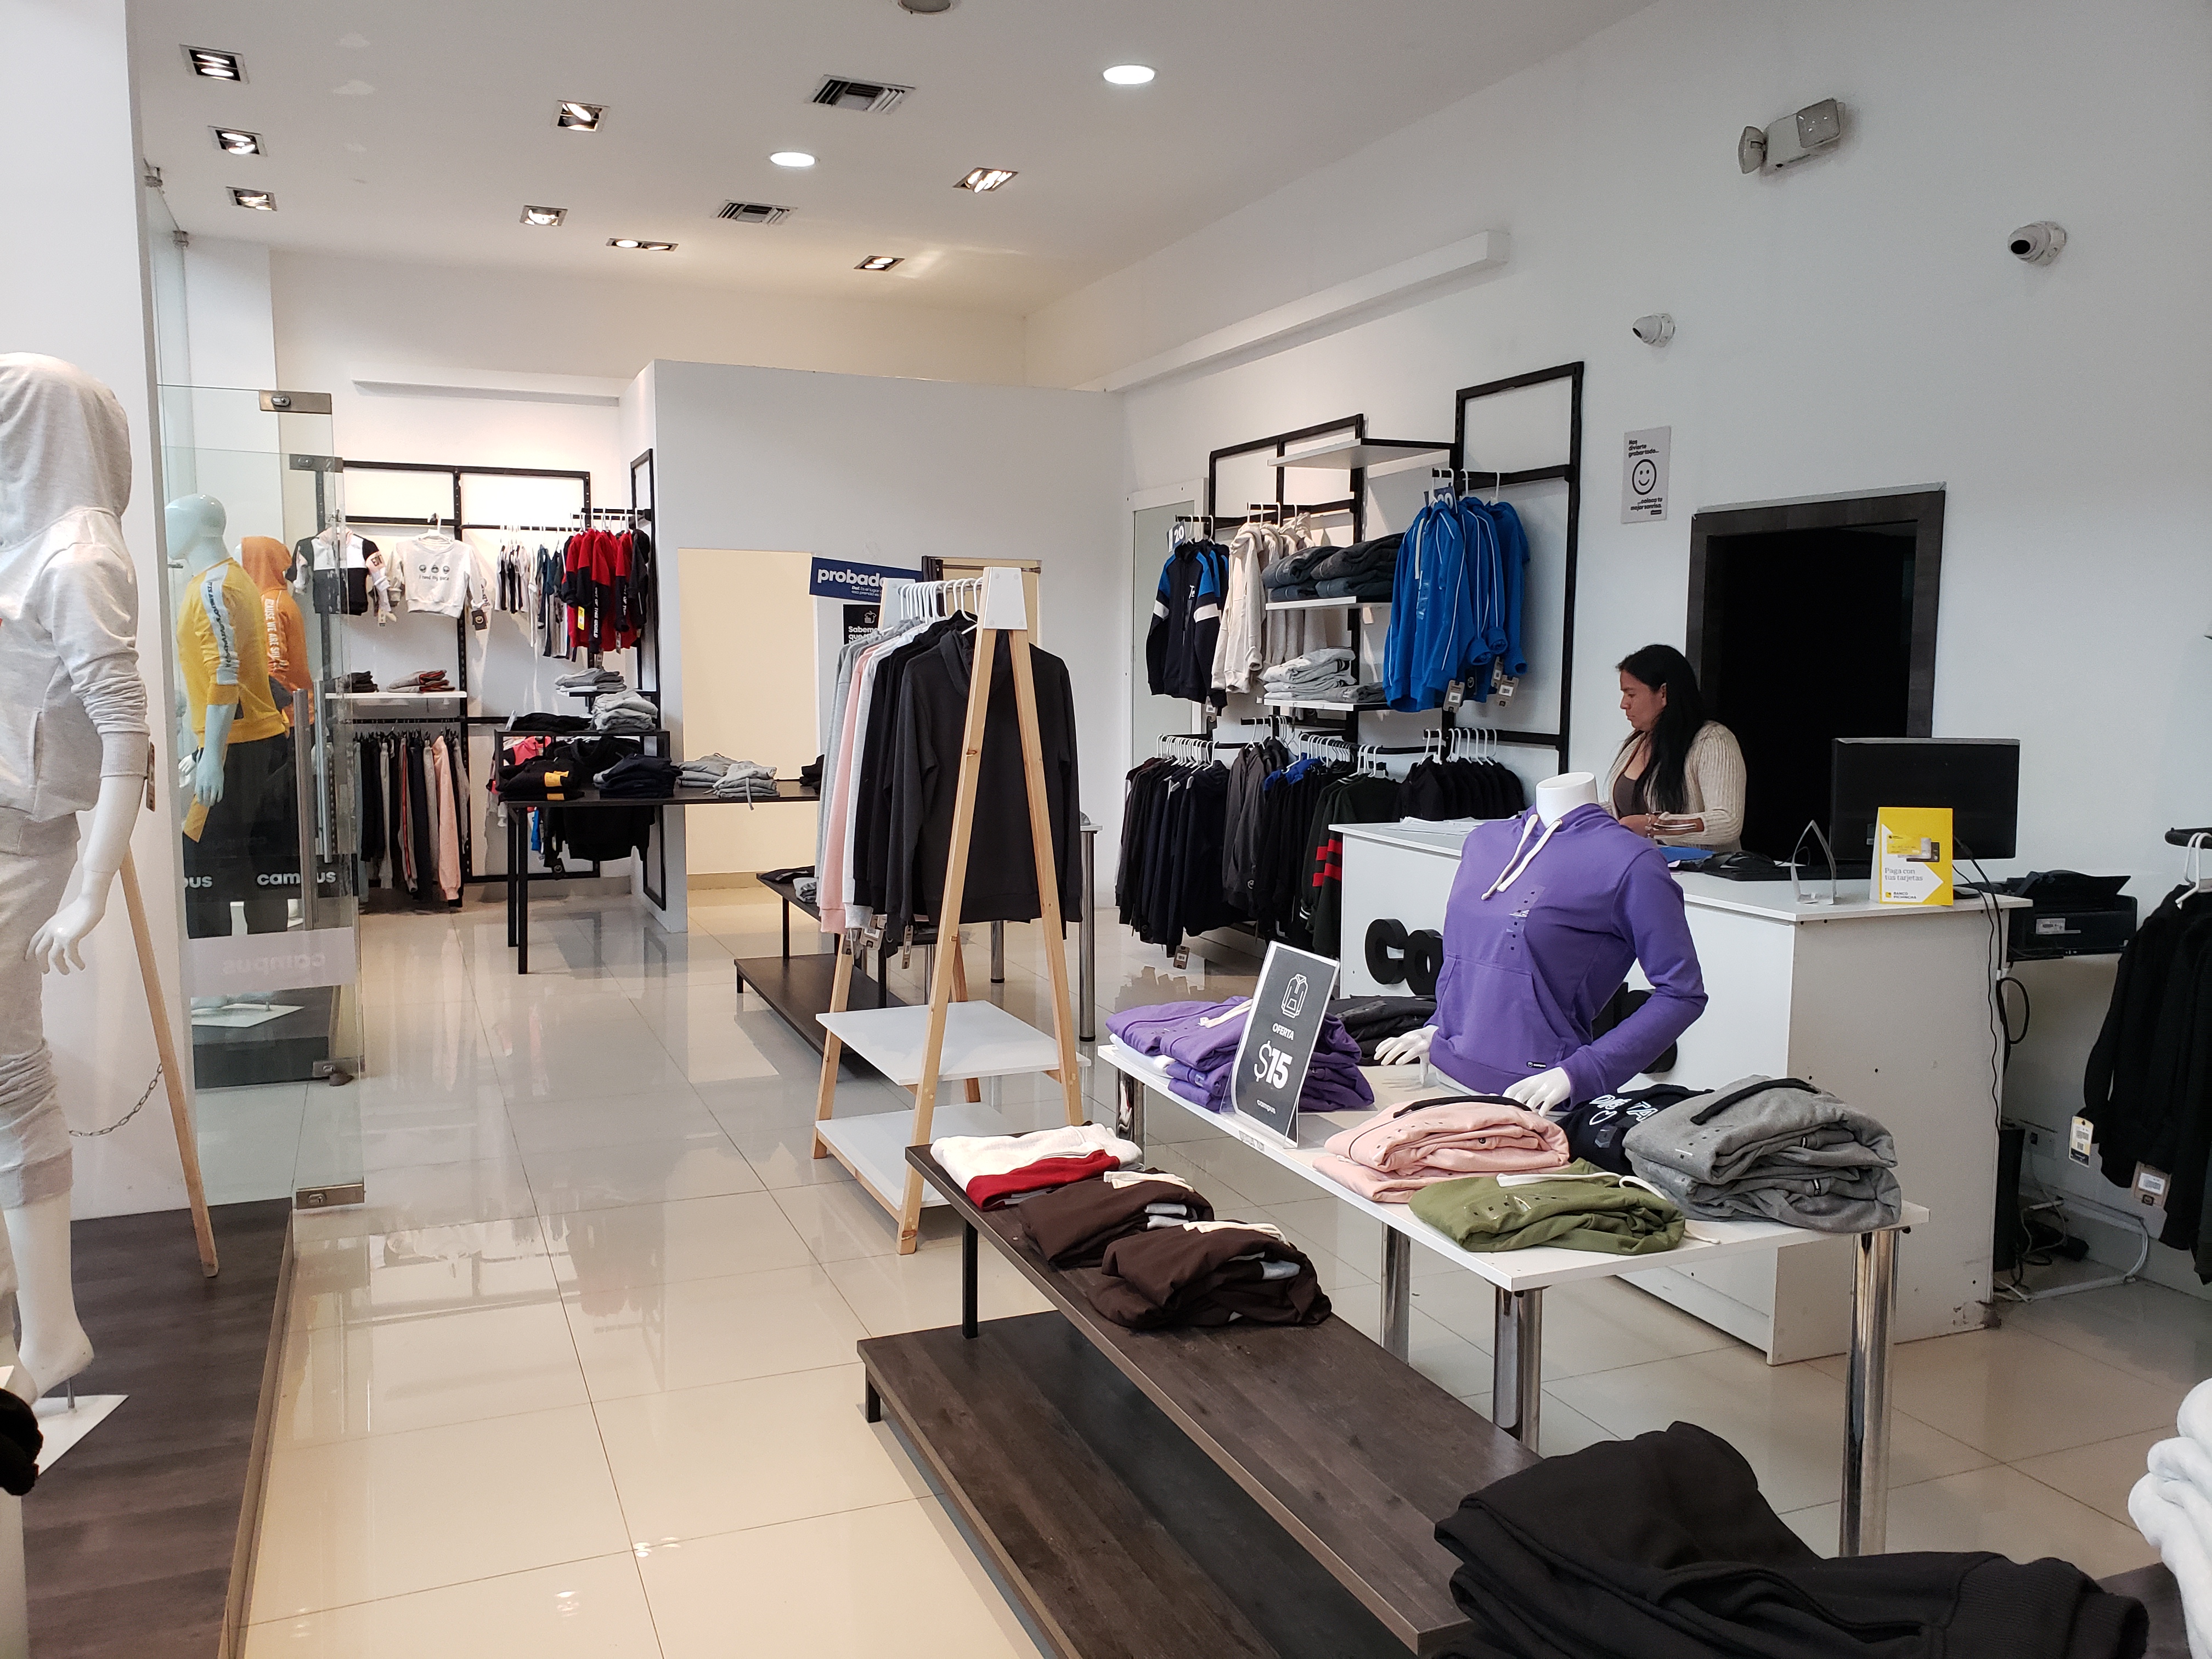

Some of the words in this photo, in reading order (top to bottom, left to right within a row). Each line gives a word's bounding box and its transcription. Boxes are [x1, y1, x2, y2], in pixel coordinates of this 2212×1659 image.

[1174, 524, 1184, 544] 20
[268, 633, 279, 646] ARE
[256, 871, 337, 885] camus
[1272, 1023, 1295, 1041] OFERTA
[1254, 1040, 1293, 1090] $15
